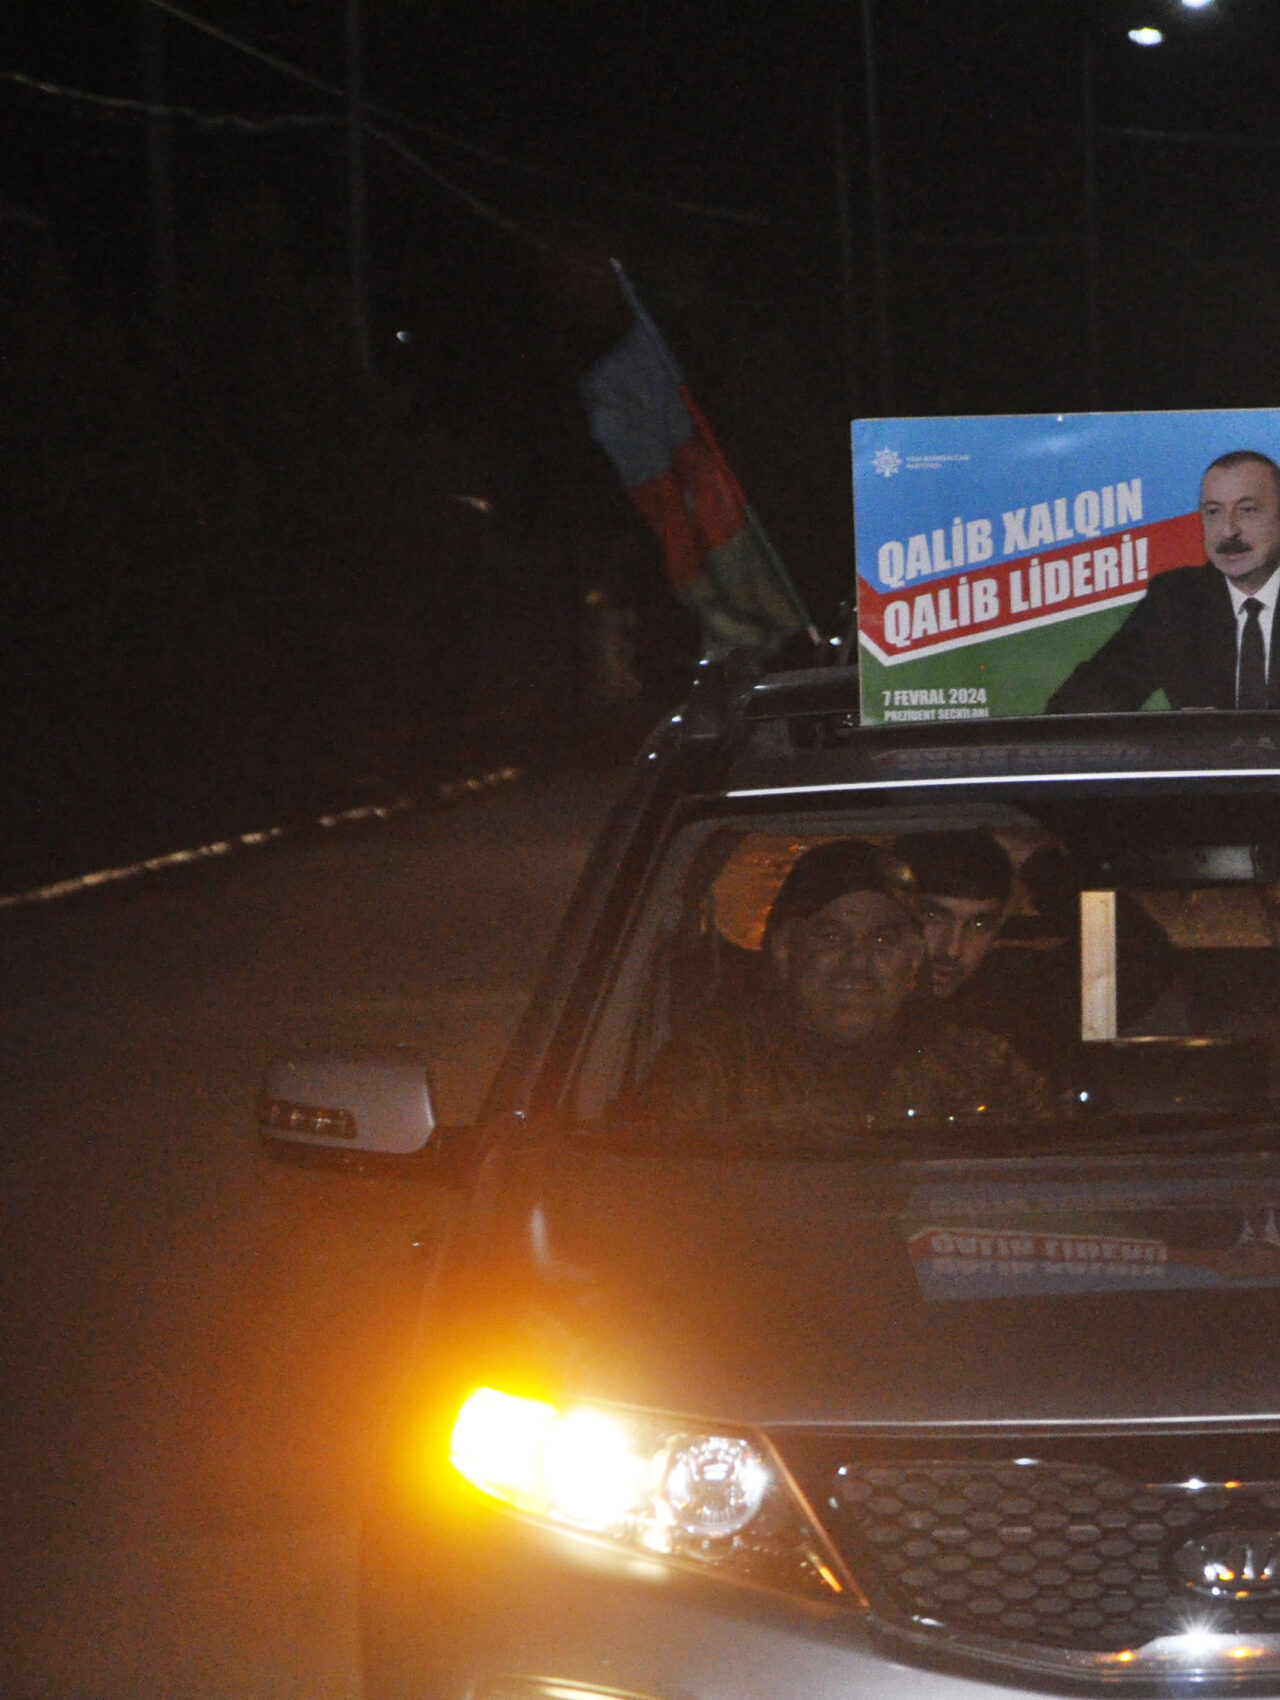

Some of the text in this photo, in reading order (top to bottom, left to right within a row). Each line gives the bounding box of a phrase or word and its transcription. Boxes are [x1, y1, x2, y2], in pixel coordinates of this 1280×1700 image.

[877, 477, 1143, 588] QALİB XALQIN
[883, 534, 1149, 648] QALİB LİDERİ!
[882, 688, 987, 706] 7 FEVRAL 2024
